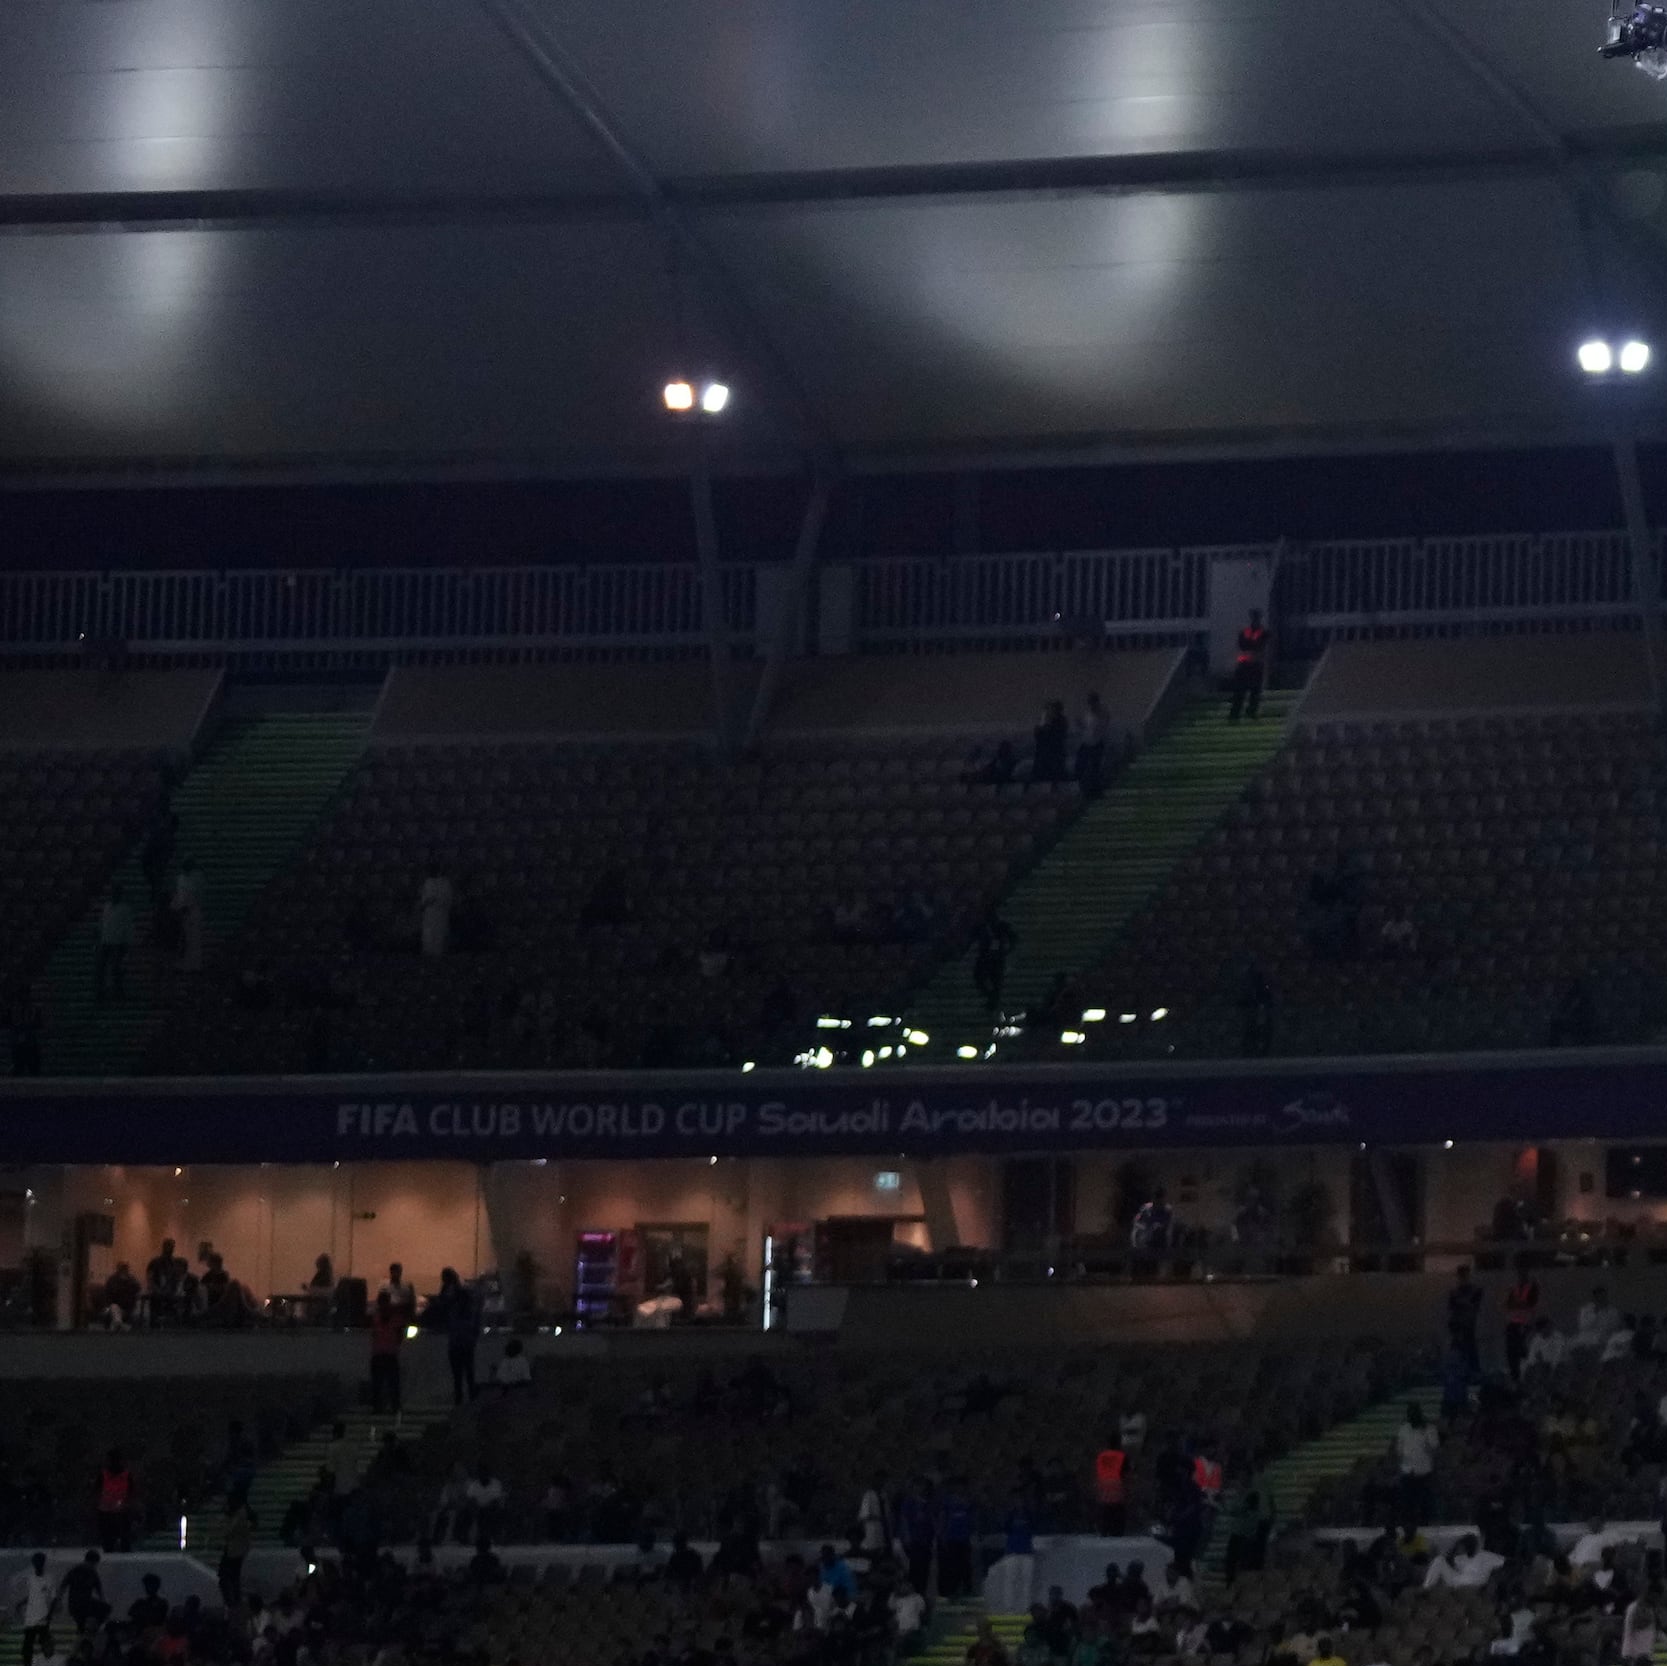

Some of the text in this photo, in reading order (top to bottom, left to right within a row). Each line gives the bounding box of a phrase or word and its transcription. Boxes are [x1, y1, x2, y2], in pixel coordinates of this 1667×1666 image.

[337, 1103, 418, 1136] FIFA
[429, 1103, 521, 1136] CLUB
[531, 1103, 665, 1136] WORLD
[676, 1101, 747, 1135] CUP
[759, 1101, 889, 1134] Saudi
[901, 1098, 1061, 1133] Arabia
[1071, 1098, 1168, 1129] 2023
